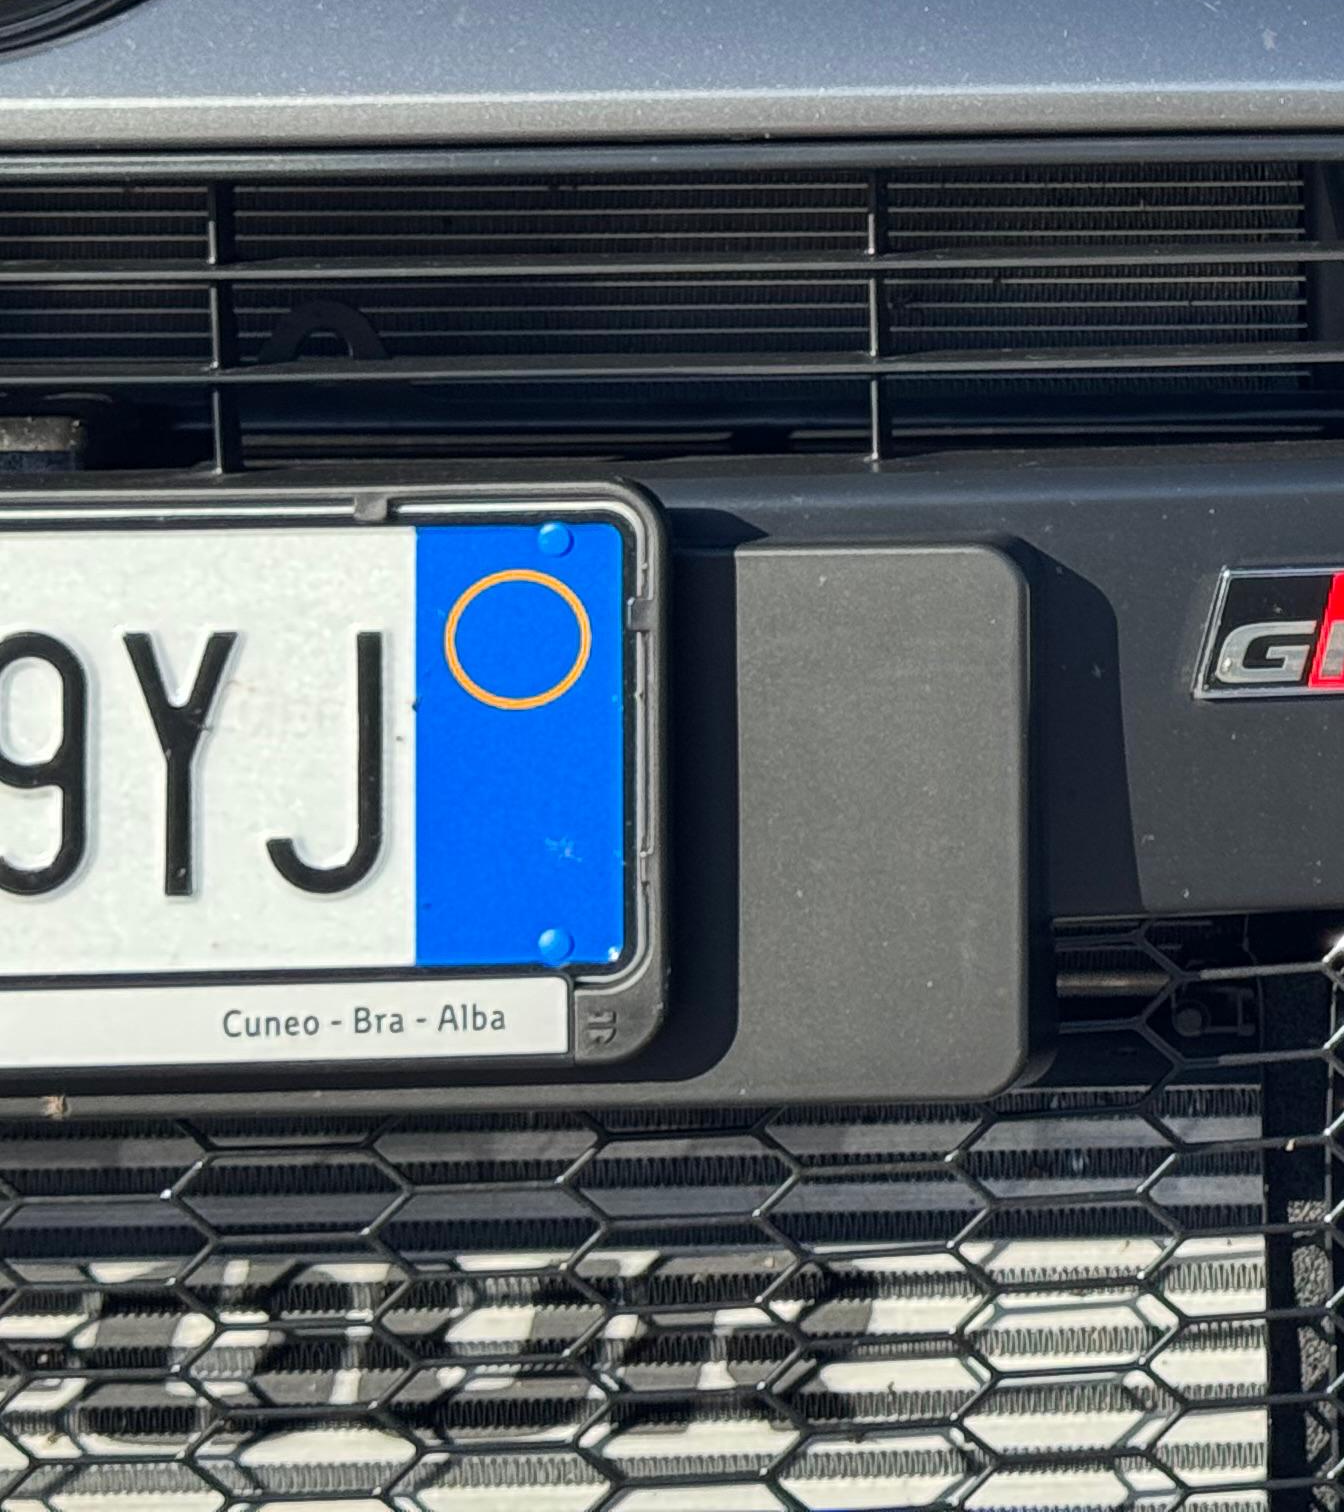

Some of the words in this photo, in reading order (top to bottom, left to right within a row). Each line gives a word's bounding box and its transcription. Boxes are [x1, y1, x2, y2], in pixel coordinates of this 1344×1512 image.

[0, 631, 385, 896] 9YJ
[222, 1009, 320, 1038] Cuneo
[353, 1005, 405, 1034] Bra
[437, 1003, 507, 1033] Alba
